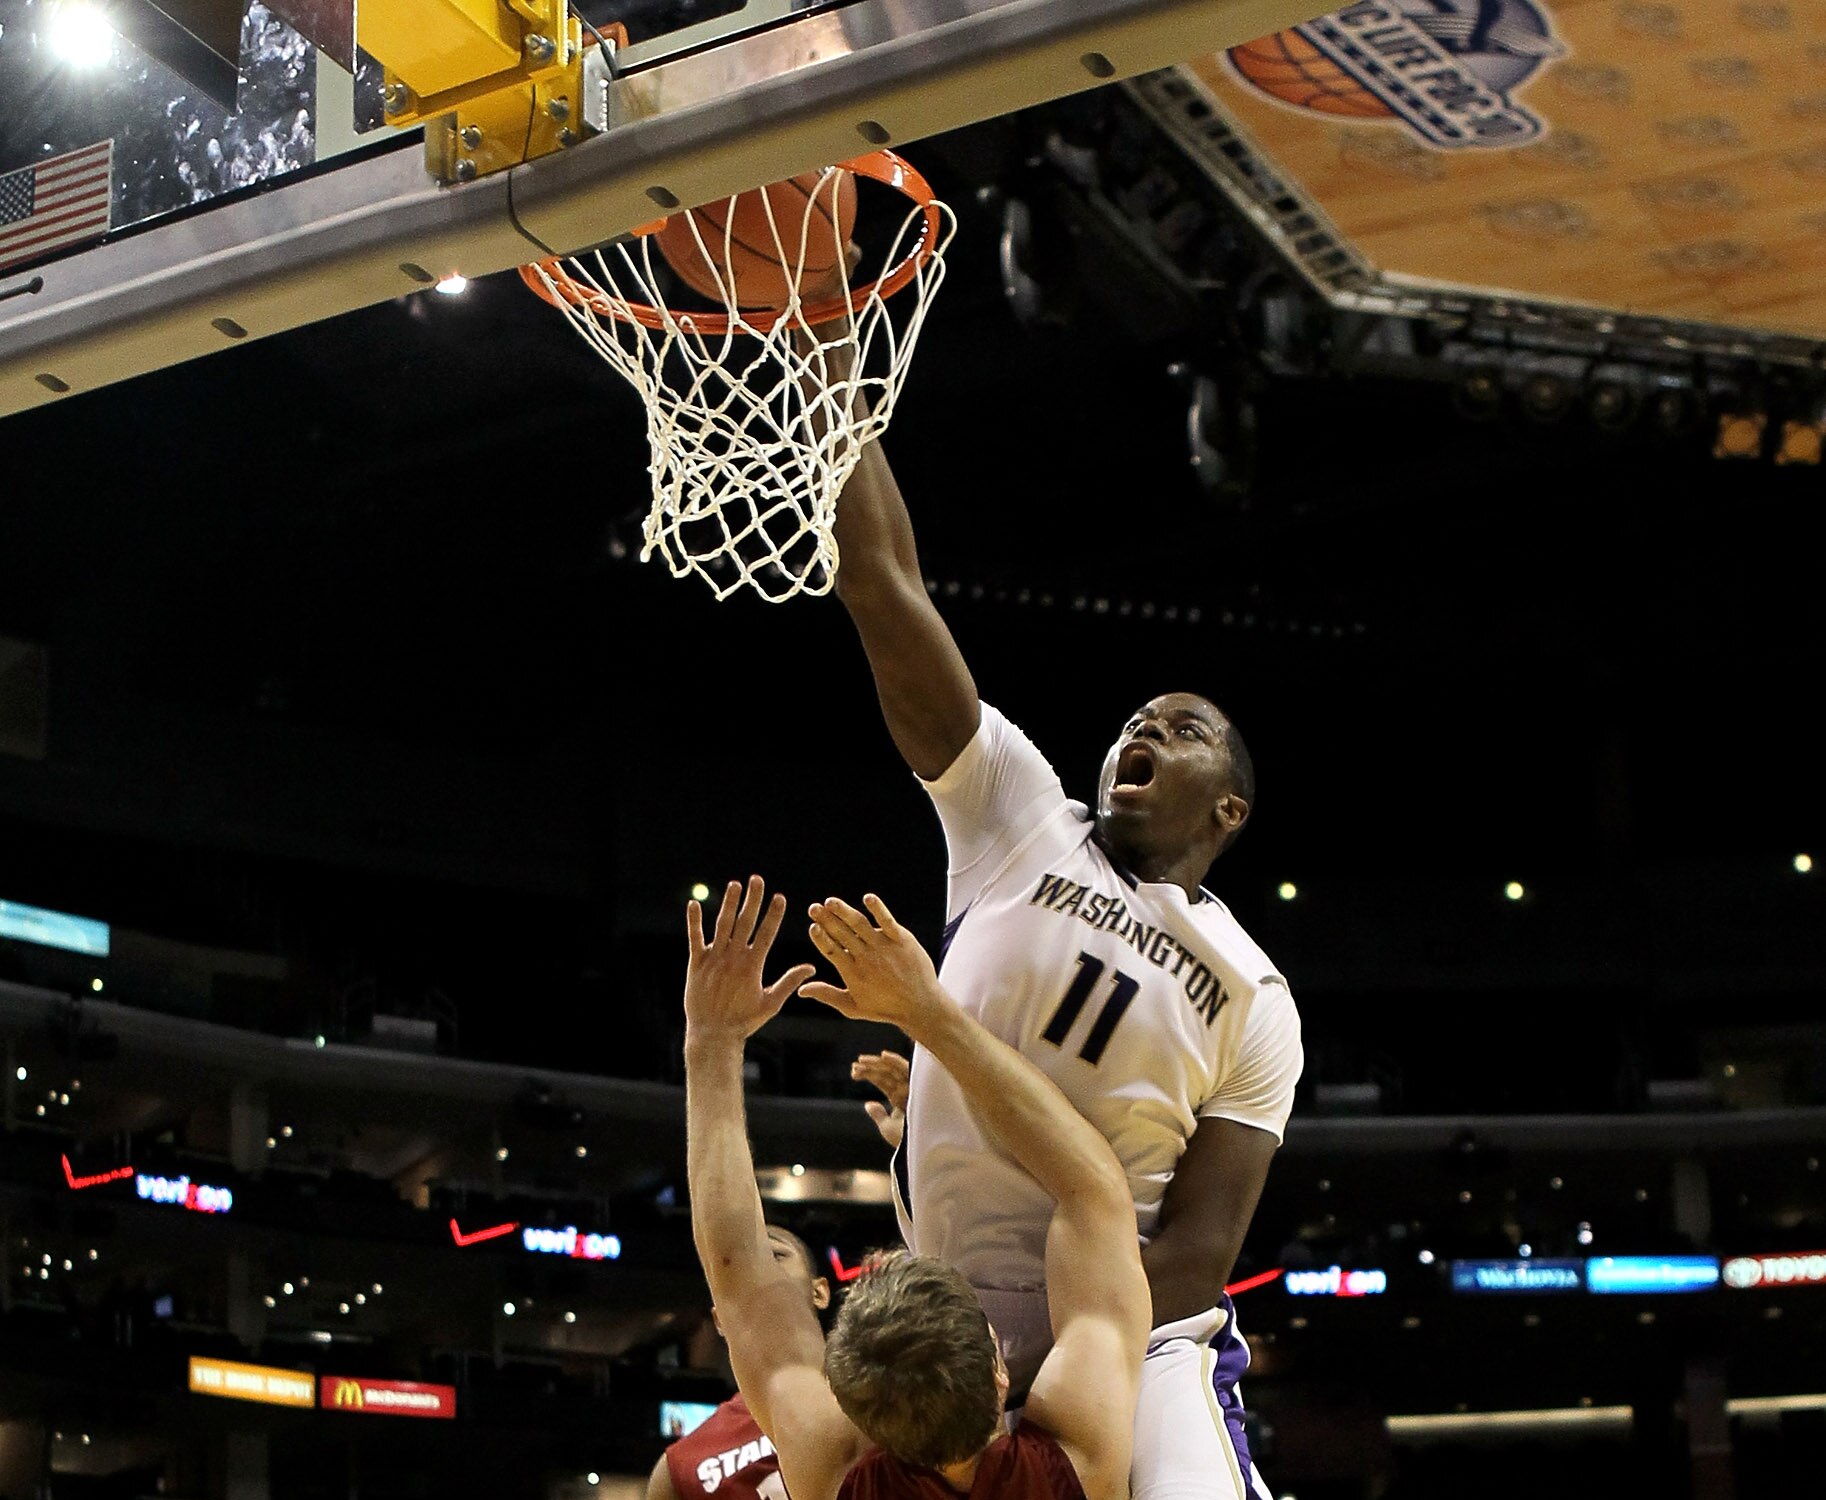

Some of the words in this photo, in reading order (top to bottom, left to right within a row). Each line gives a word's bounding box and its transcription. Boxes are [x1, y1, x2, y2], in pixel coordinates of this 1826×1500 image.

[1028, 873, 1230, 1029] WASHINGTON
[1039, 950, 1141, 1066] 11
[522, 1225, 622, 1260] verizon
